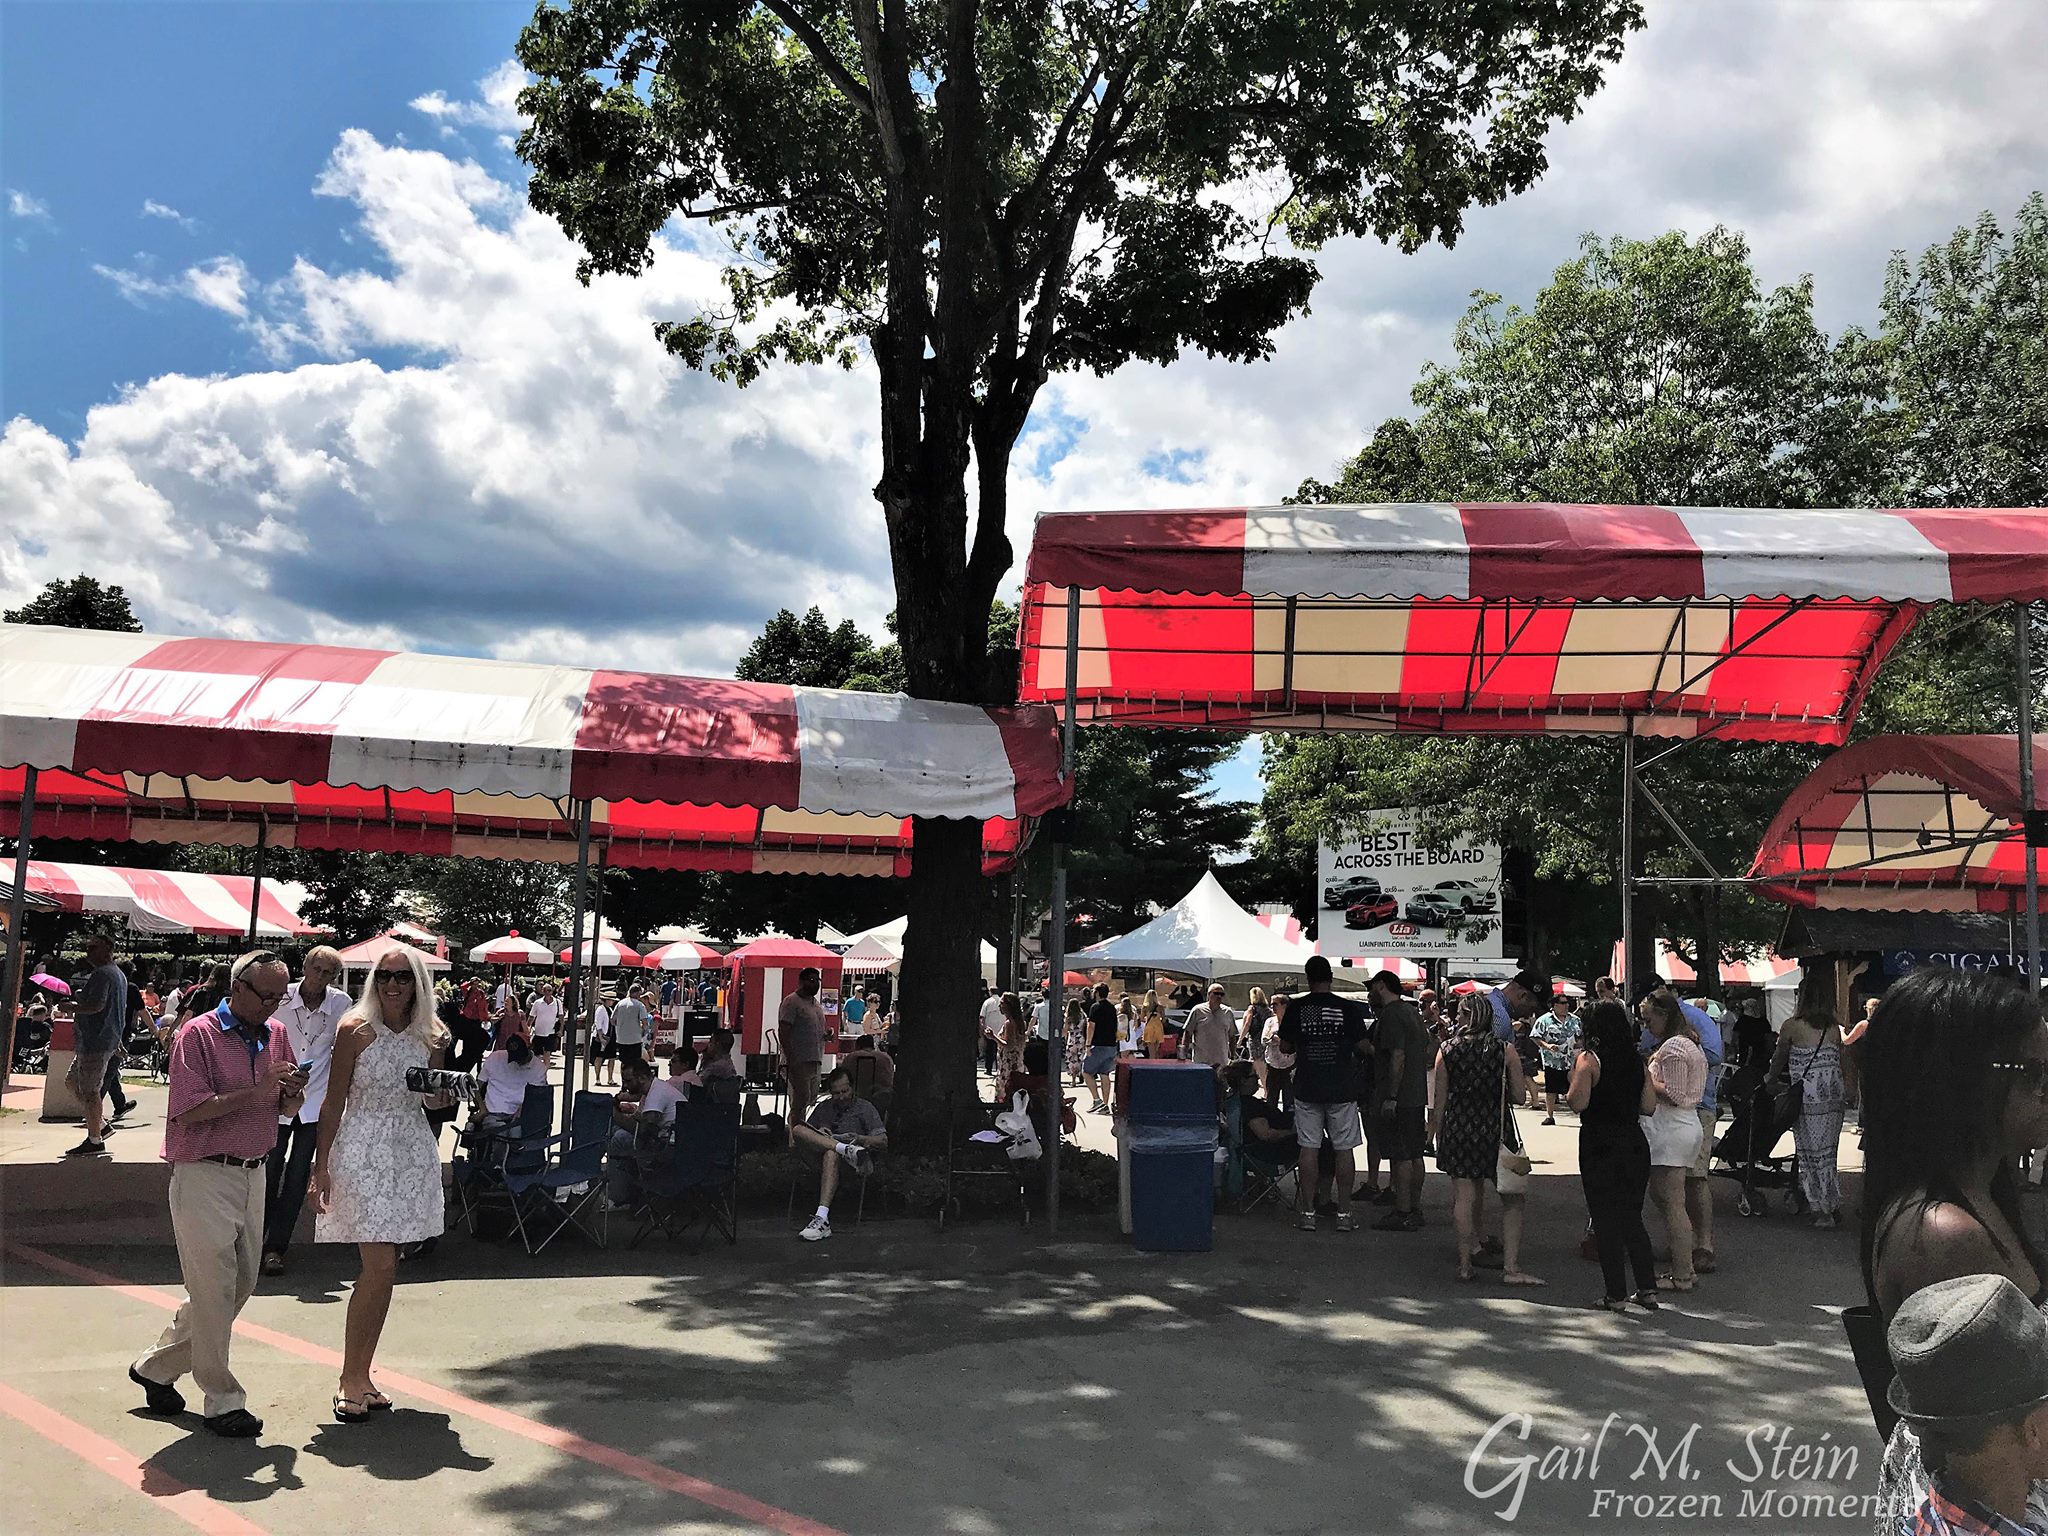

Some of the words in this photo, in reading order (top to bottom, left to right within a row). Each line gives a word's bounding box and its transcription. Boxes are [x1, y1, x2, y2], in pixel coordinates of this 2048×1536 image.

[1361, 831, 1411, 852] BEST
[1334, 853, 1392, 869] ACROSS
[1394, 851, 1425, 866] THE
[1427, 849, 1485, 865] BOARD
[1392, 924, 1411, 934] Lia
